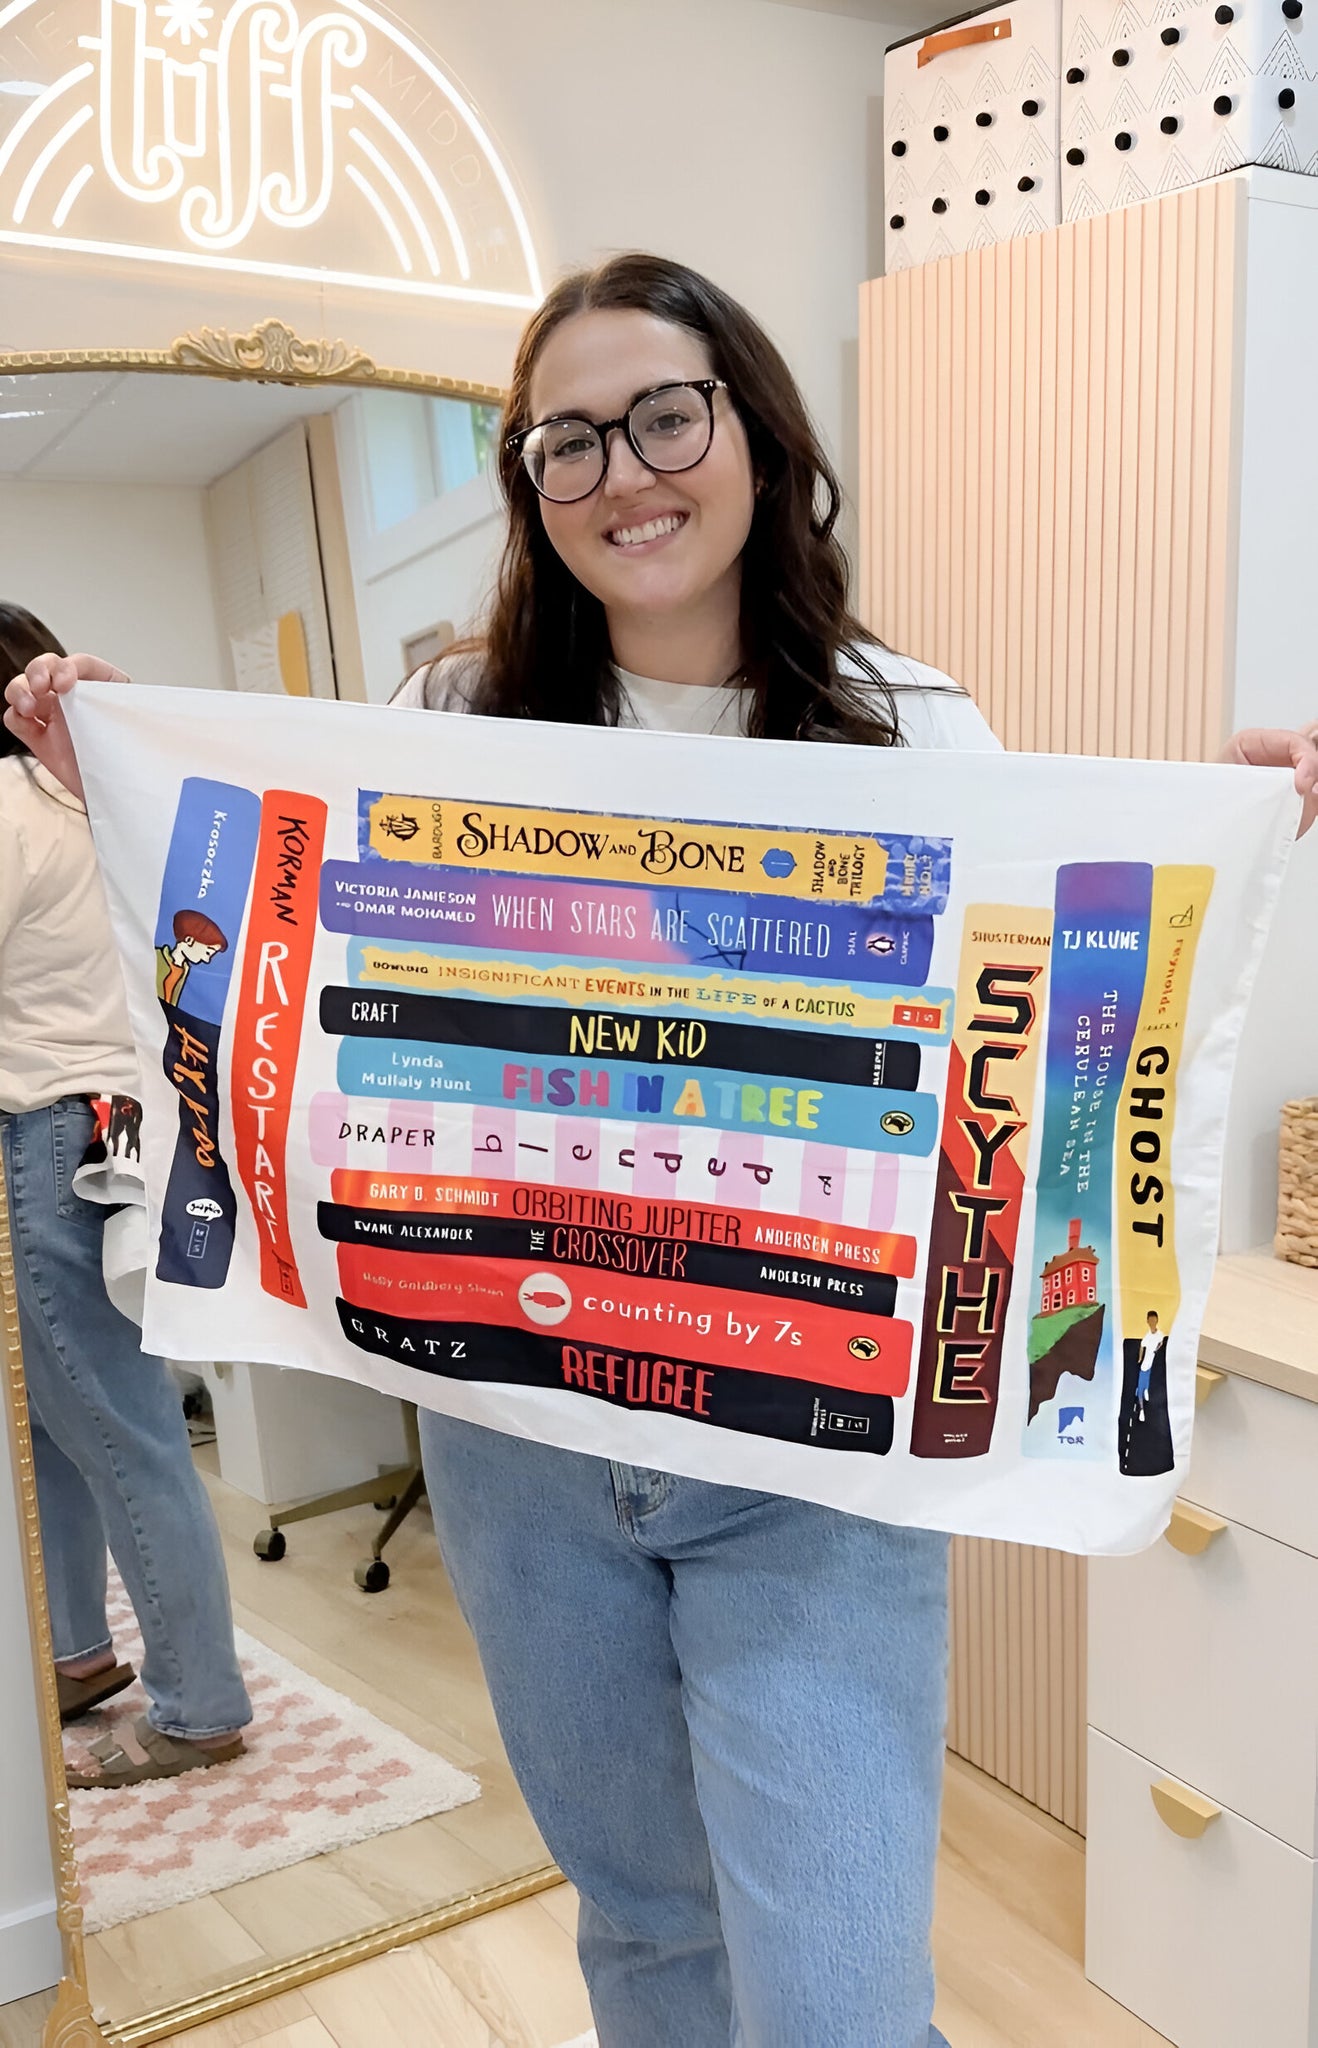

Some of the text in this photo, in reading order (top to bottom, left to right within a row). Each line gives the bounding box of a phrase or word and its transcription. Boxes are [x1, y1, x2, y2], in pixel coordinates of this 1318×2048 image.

[456, 812, 745, 875] SHADOW AND BONE
[270, 815, 310, 926] KORMAN
[812, 841, 826, 893] SHADOW
[837, 853, 850, 885] BONE
[850, 844, 865, 896] TRILOGY
[335, 880, 476, 906] VICTORIA JAMIESON
[354, 900, 396, 916] OMAR
[401, 905, 476, 923] MOHAMED
[491, 893, 830, 958] WHEN STARS ARE SCATTERED
[970, 930, 1052, 948] SHUSTERMAN
[1062, 929, 1140, 951] TJ KLUNE
[351, 1001, 400, 1024] CRAFT
[438, 966, 580, 990] INSIGNIFICANT
[585, 978, 646, 997] EVENTS
[650, 986, 662, 997] IN
[667, 986, 690, 999] THE
[696, 987, 757, 1006] LIFE
[763, 997, 778, 1008] OF
[781, 999, 790, 1010] A
[795, 998, 855, 1018] CACTUS
[569, 1014, 641, 1055] NEW
[361, 1072, 472, 1092] Mullaly Hunt
[392, 1052, 444, 1070] Lynda
[247, 941, 289, 1244] RESTART
[502, 1063, 823, 1130] FISH IN A TREE
[1060, 1015, 1091, 1175] CERULEAN SEA
[1076, 990, 1118, 1193] THE HOUSE IN THE
[338, 1122, 435, 1147] DRAPER
[1129, 1045, 1170, 1248] GHOST
[474, 1134, 773, 1185] blended
[369, 1183, 499, 1208] GARY D. SCHMIDT
[933, 962, 1043, 1404] SCYTHE
[400, 1225, 473, 1242] ALEXANDER
[513, 1188, 742, 1246] ORBITING JUPITER
[530, 1228, 545, 1252] THE
[553, 1227, 688, 1278] CROSSOVER
[754, 1226, 881, 1266] ANDERSEN PRESS
[760, 1266, 864, 1297] ANDERSEN PRESS
[351, 1318, 467, 1359] GRATZ
[583, 1296, 803, 1347] counting by 7s
[560, 1345, 715, 1416] REFUGEE
[1057, 1435, 1085, 1446] TOR
